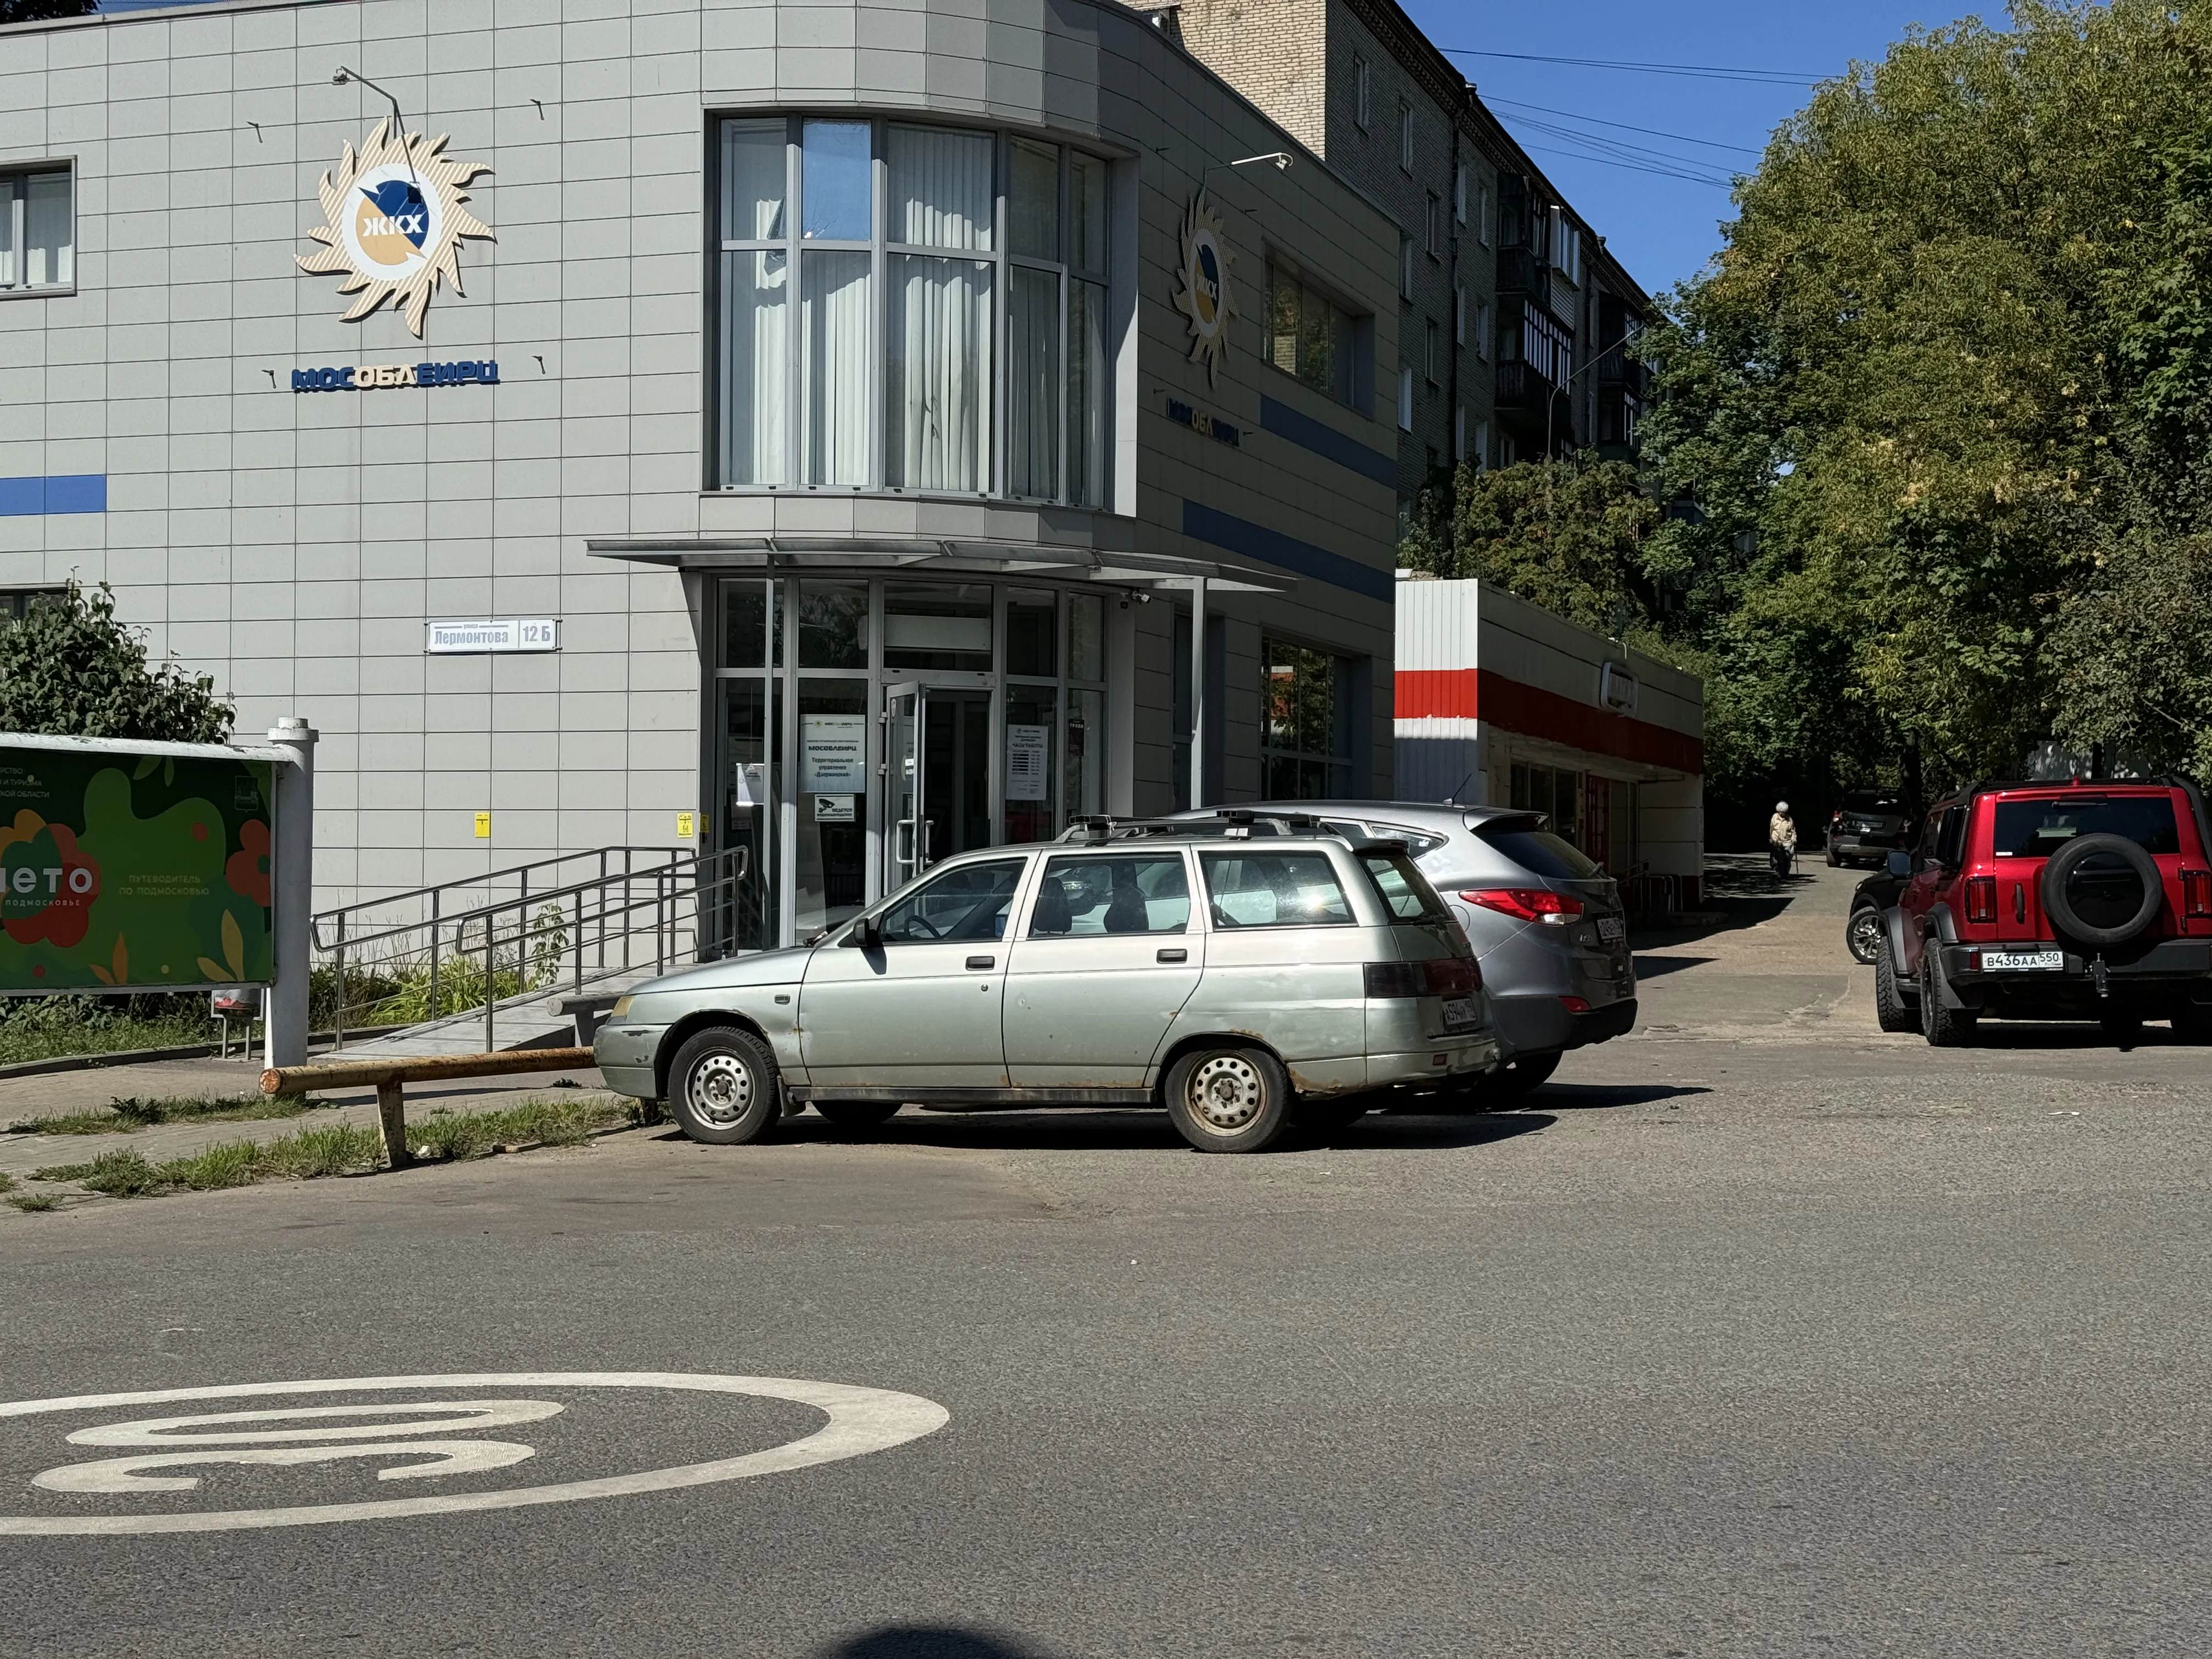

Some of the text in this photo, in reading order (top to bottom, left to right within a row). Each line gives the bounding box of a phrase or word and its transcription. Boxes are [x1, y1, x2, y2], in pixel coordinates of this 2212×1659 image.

[363, 214, 423, 236] ЖКХ
[1197, 273, 1217, 301] ЖКХ
[291, 359, 498, 390] МОСОБЛЕИРЦ
[434, 626, 550, 645] Лермонтова 12 Б
[129, 874, 201, 883] ПУТЕВОДИТЕЛЬ
[119, 887, 210, 896] ПО ПОДМОСКОВЬЮ
[2040, 952, 2059, 962] 550
